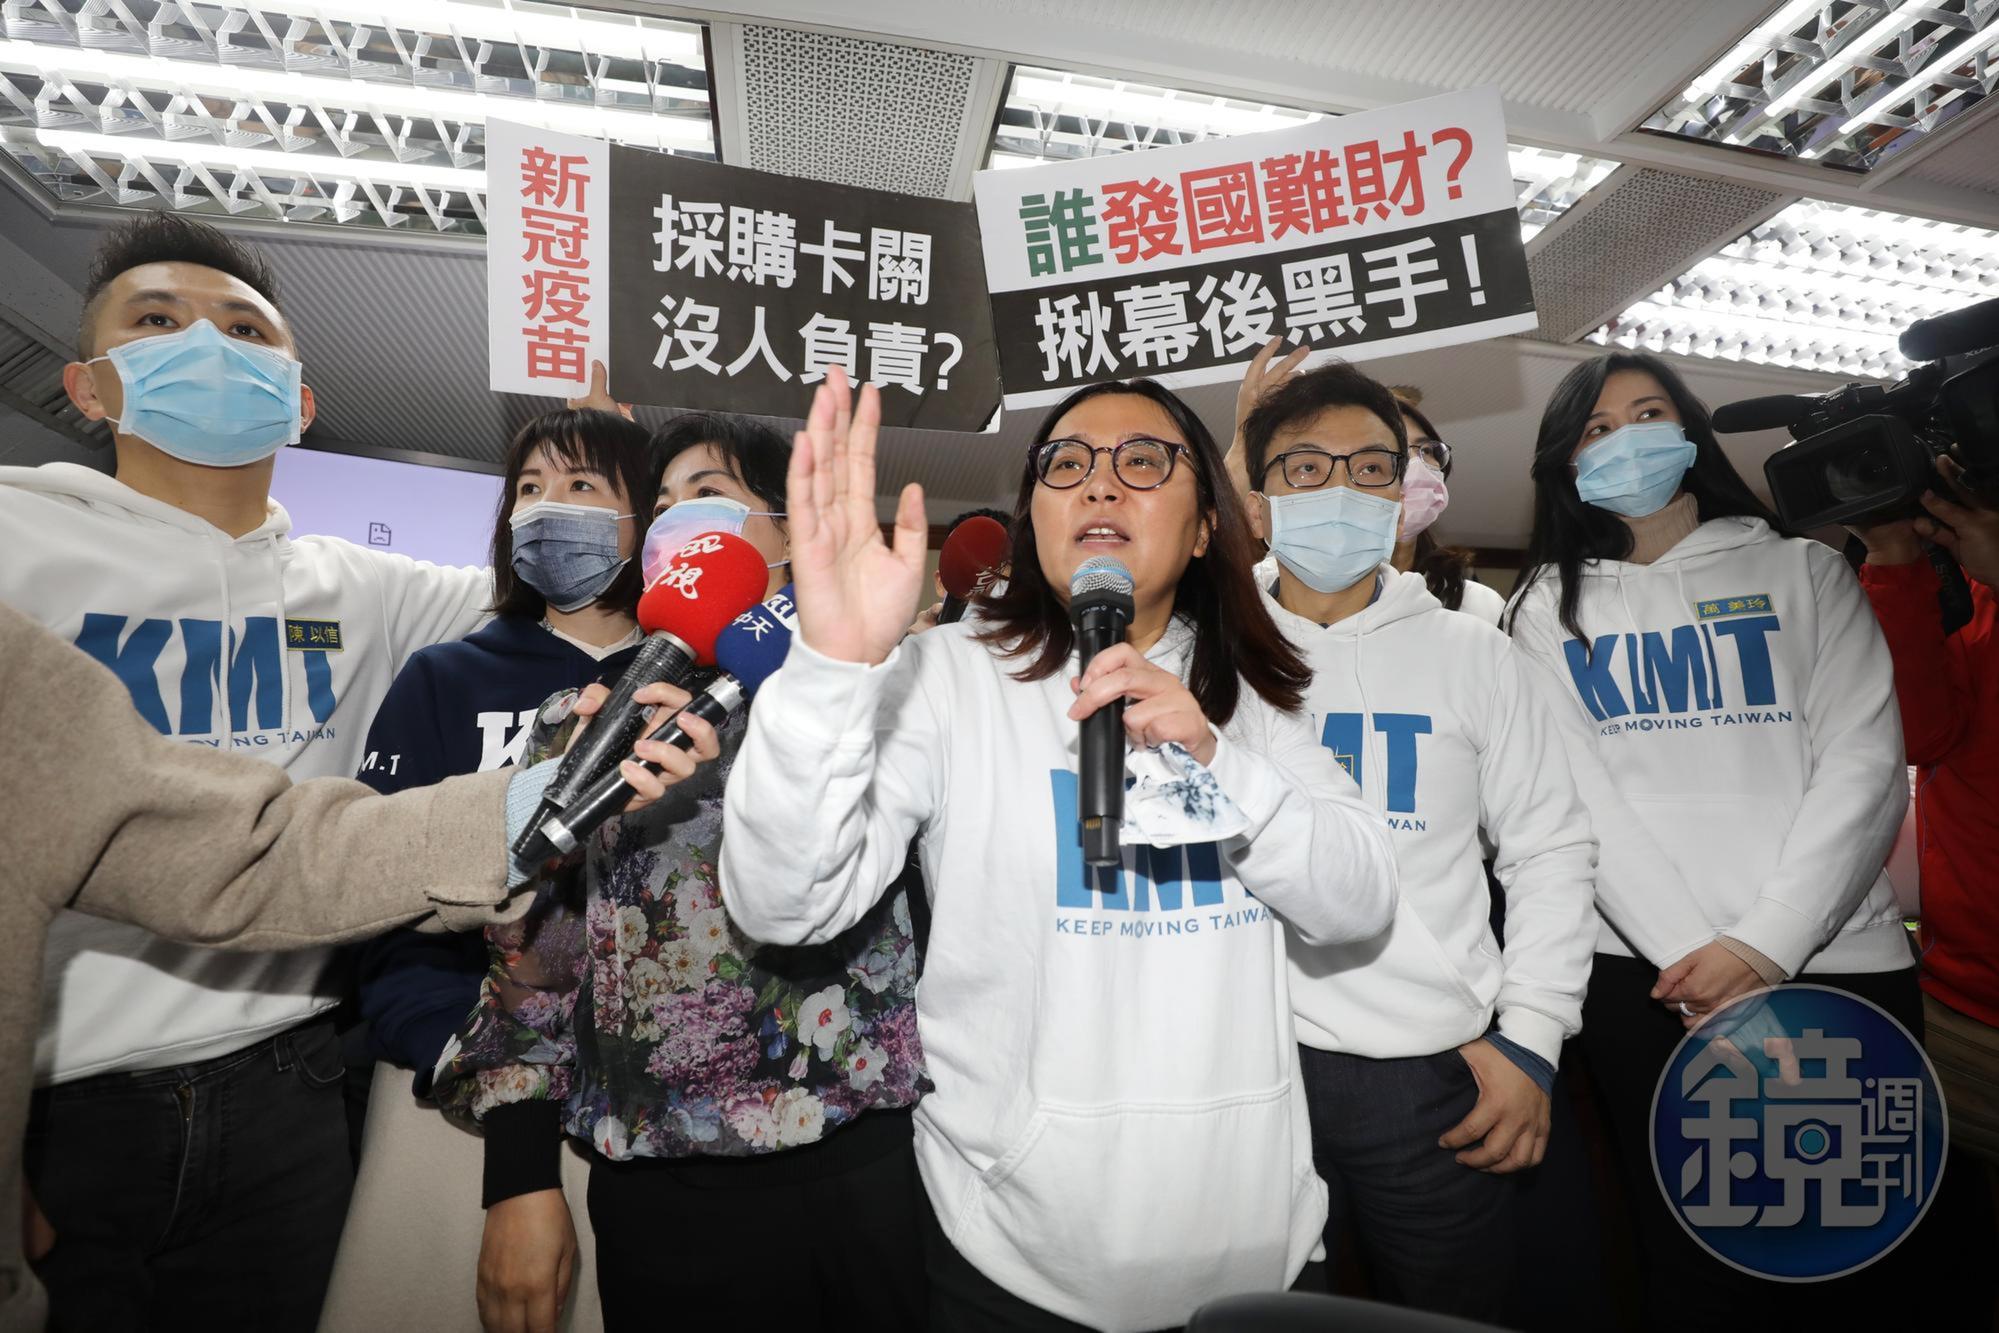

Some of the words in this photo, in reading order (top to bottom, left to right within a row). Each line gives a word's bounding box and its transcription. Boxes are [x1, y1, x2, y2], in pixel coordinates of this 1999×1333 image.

[652, 193, 932, 306] 採購卡關
[1018, 126, 1474, 278] 誰發國難財?
[521, 146, 591, 384] 新冠疫苗
[1035, 234, 1488, 382] 揪幕後黑手!
[651, 294, 964, 395] 沒人負責?
[1562, 615, 1781, 722] KMT
[1625, 717, 1703, 731] MOVING
[1711, 711, 1793, 726] TAIWAN
[1056, 917, 1113, 936] KEEP
[1120, 918, 1199, 938] MOVING
[1209, 907, 1274, 931] TAIWA
